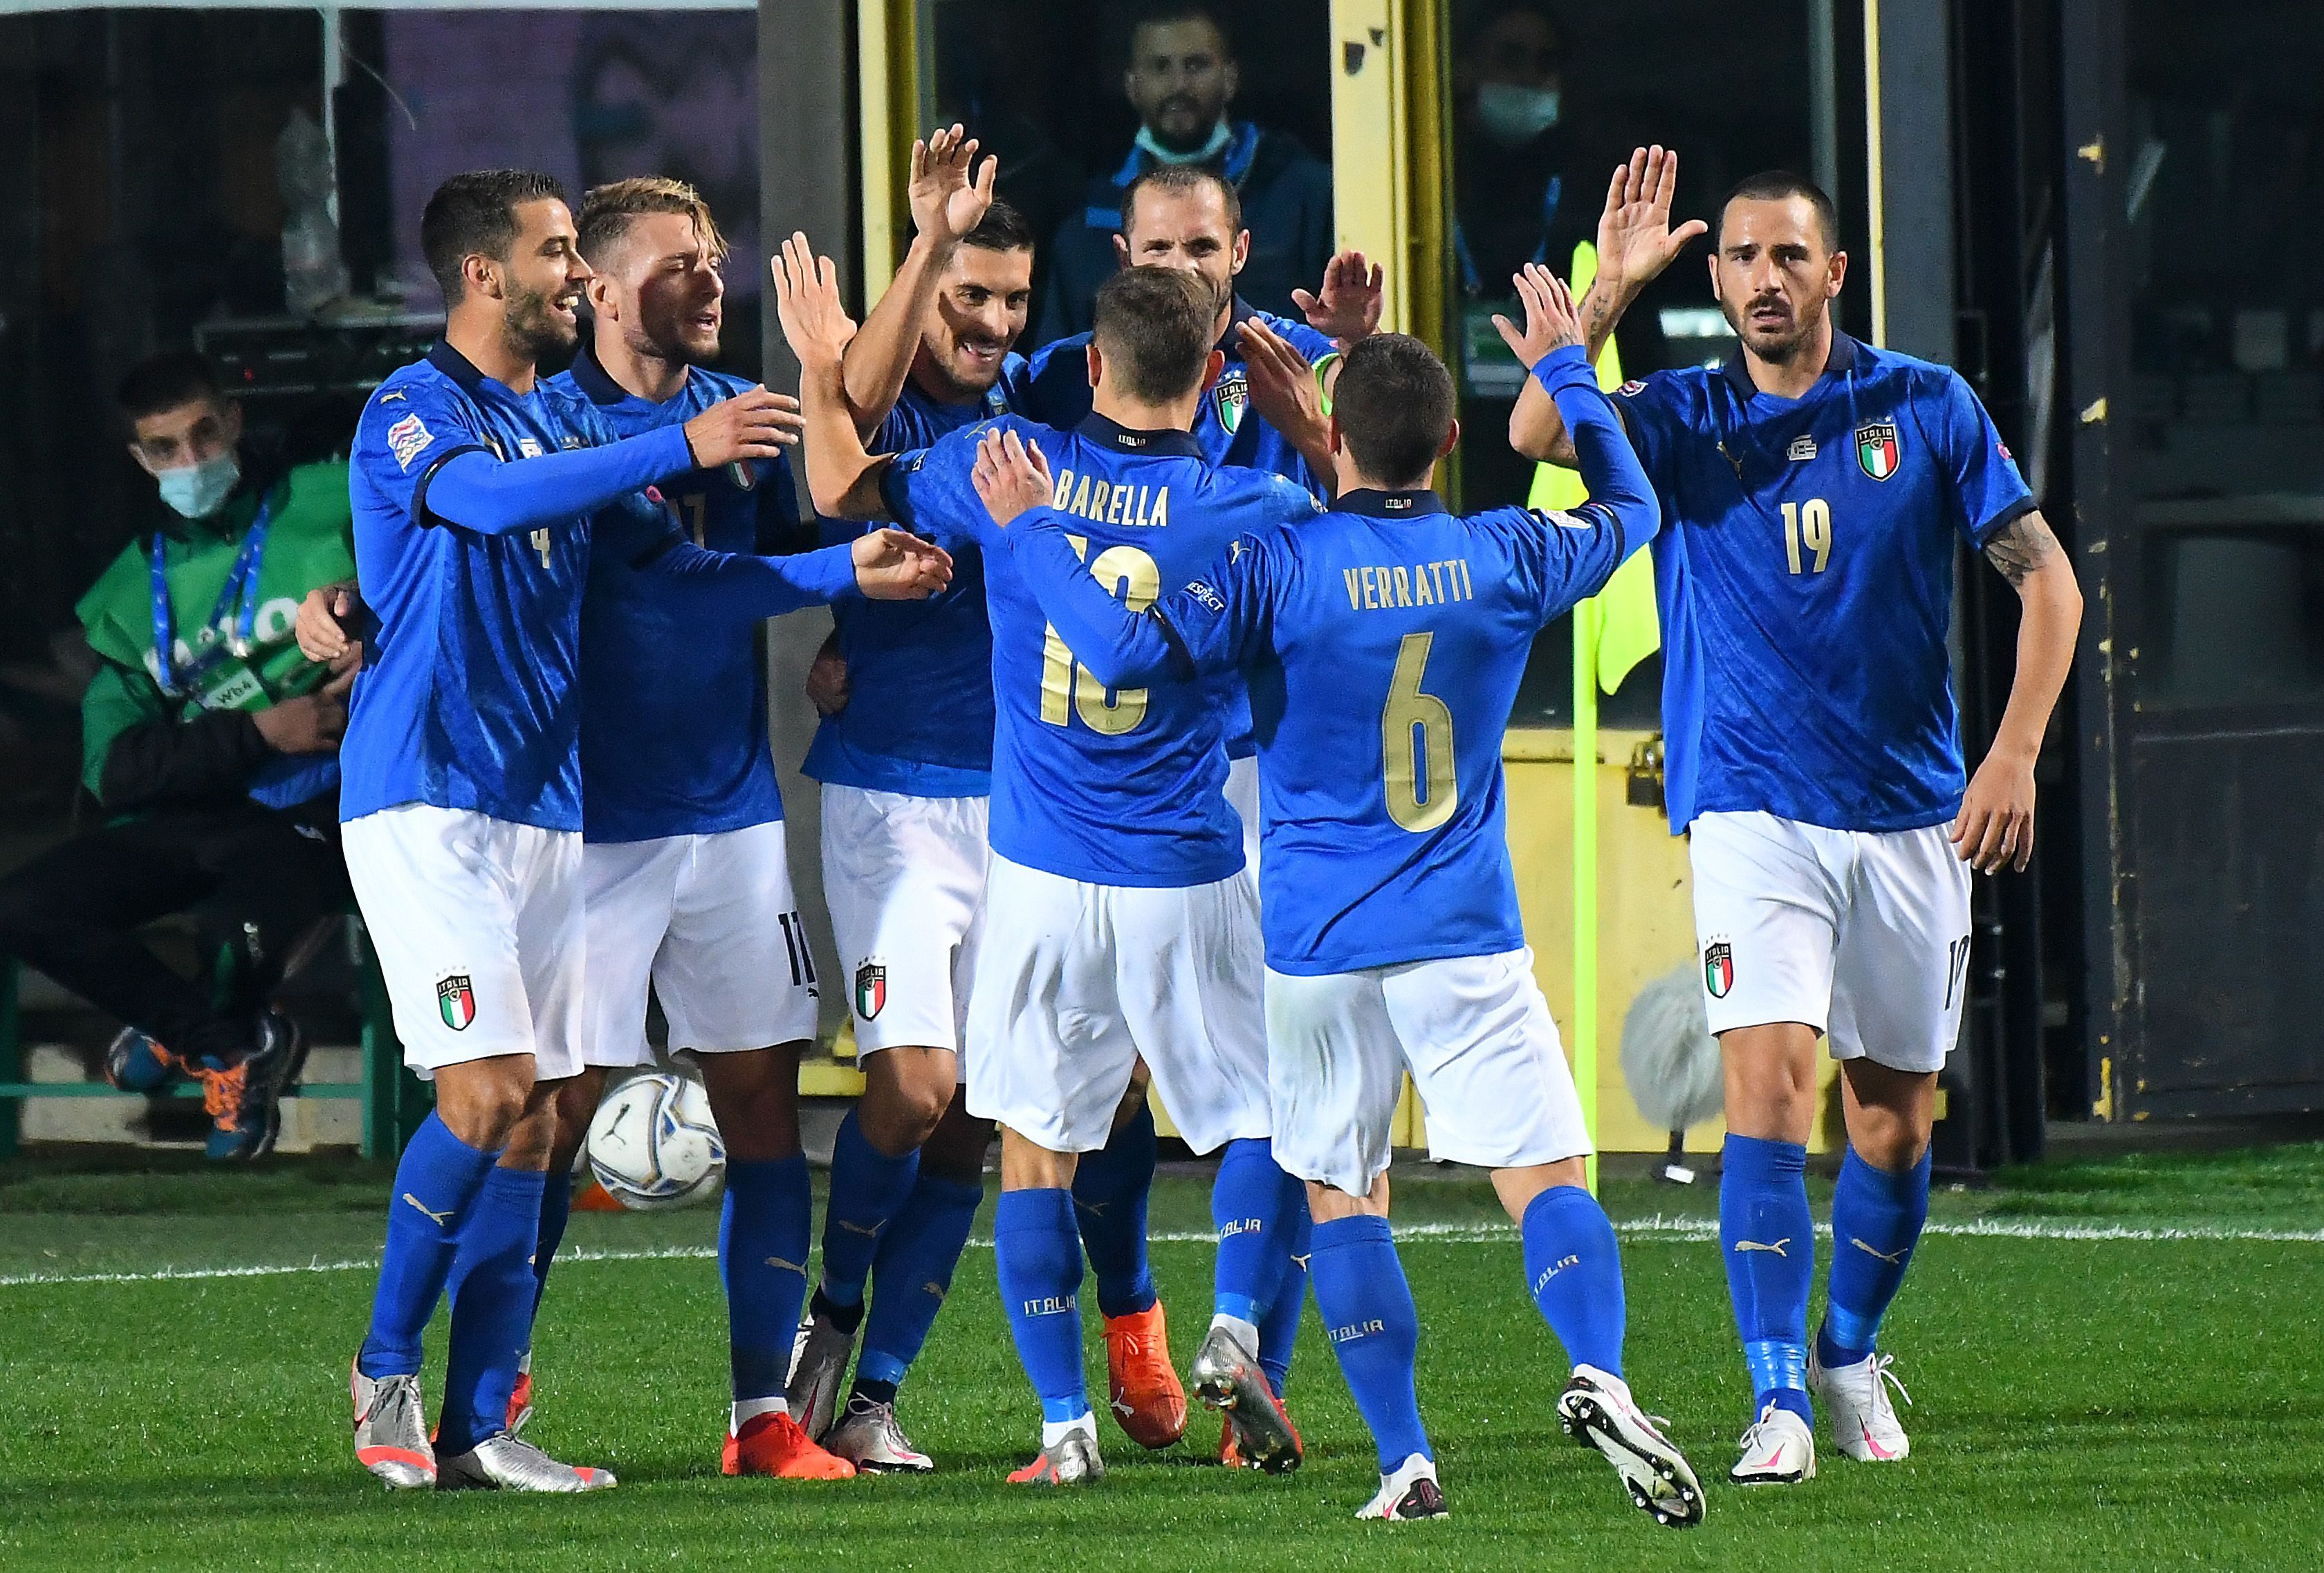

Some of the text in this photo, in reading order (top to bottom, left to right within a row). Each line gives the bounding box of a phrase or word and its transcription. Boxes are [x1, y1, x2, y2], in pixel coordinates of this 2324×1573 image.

[1859, 428, 1892, 441] ITALIA
[1052, 468, 1169, 527] BARELLA
[1385, 498, 1412, 509] ITALIA
[1780, 498, 1832, 574] 19
[1343, 558, 1473, 611] VERRATTI
[1382, 631, 1457, 833] 6
[777, 911, 816, 986] 11
[1706, 945, 1729, 959] ITALIA
[438, 977, 469, 993] ITALIA
[858, 968, 884, 980] ITALIA
[1024, 1295, 1076, 1318] ITALIA
